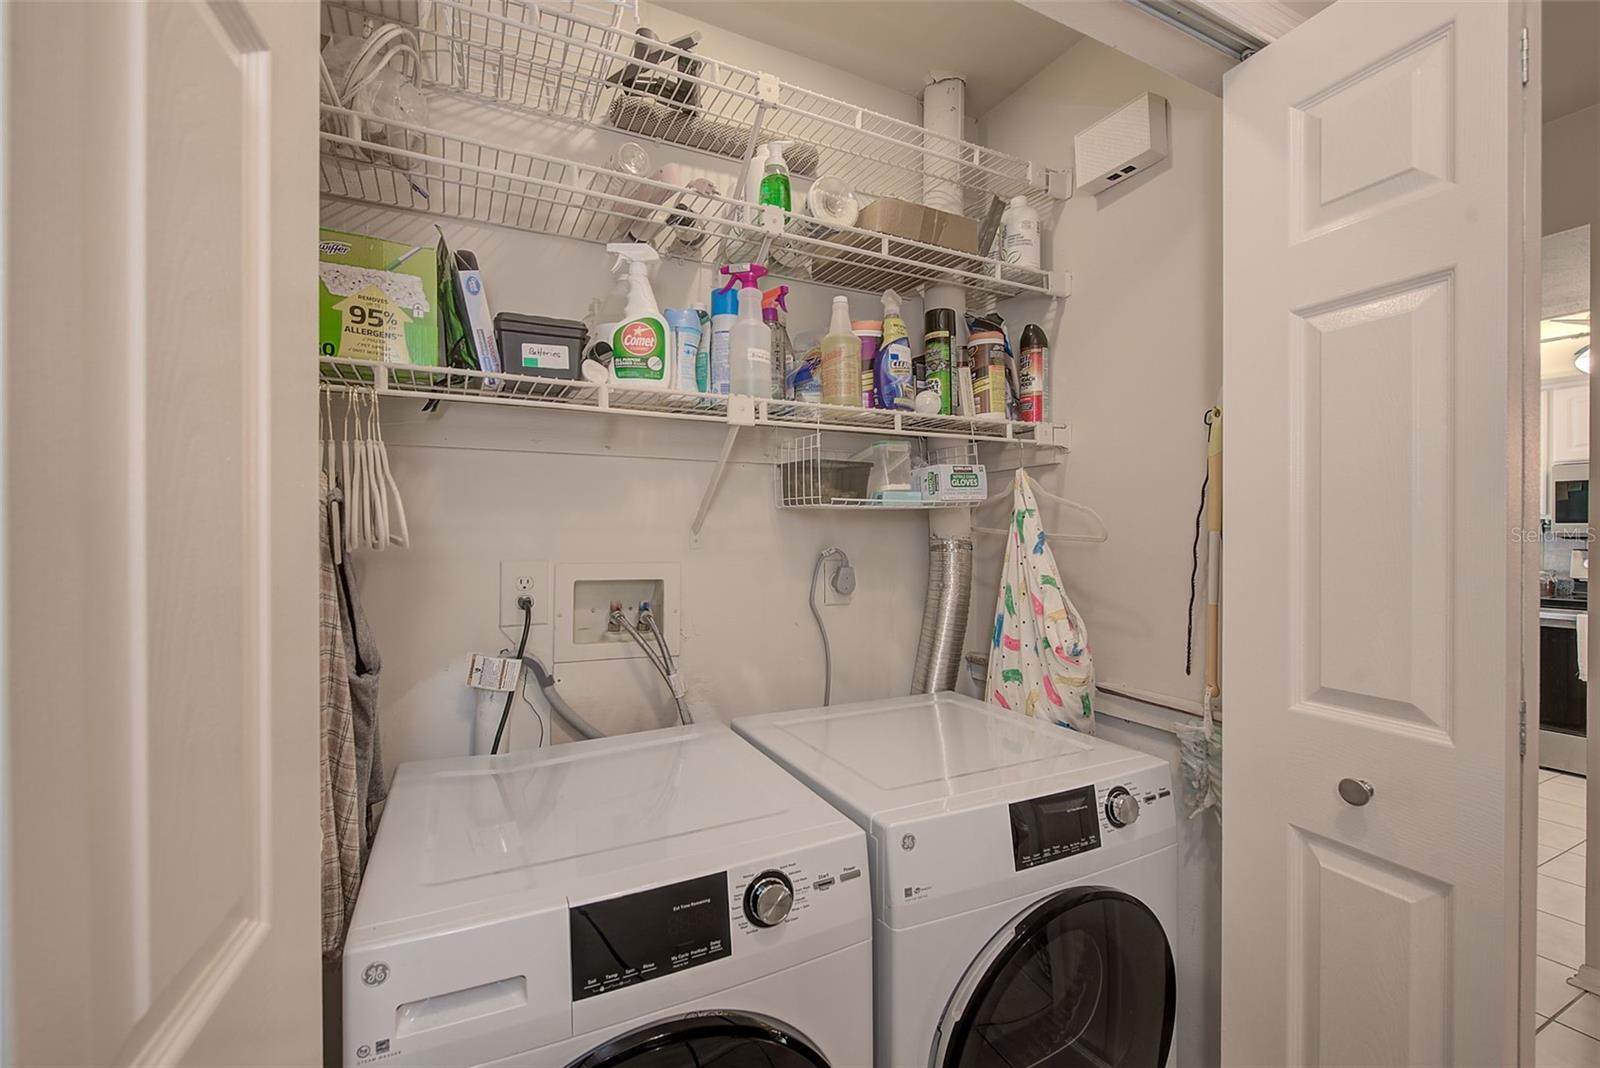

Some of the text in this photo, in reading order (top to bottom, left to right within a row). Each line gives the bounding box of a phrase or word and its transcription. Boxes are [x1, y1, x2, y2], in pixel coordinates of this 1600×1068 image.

[319, 242, 350, 255] wiffer
[357, 294, 389, 305] REMOVES
[349, 305, 398, 328] 95%
[624, 334, 655, 347] Comet
[528, 347, 561, 358] Batteries
[691, 898, 711, 907] Remaining
[678, 952, 690, 960] Cycle
[605, 972, 619, 980] Temp
